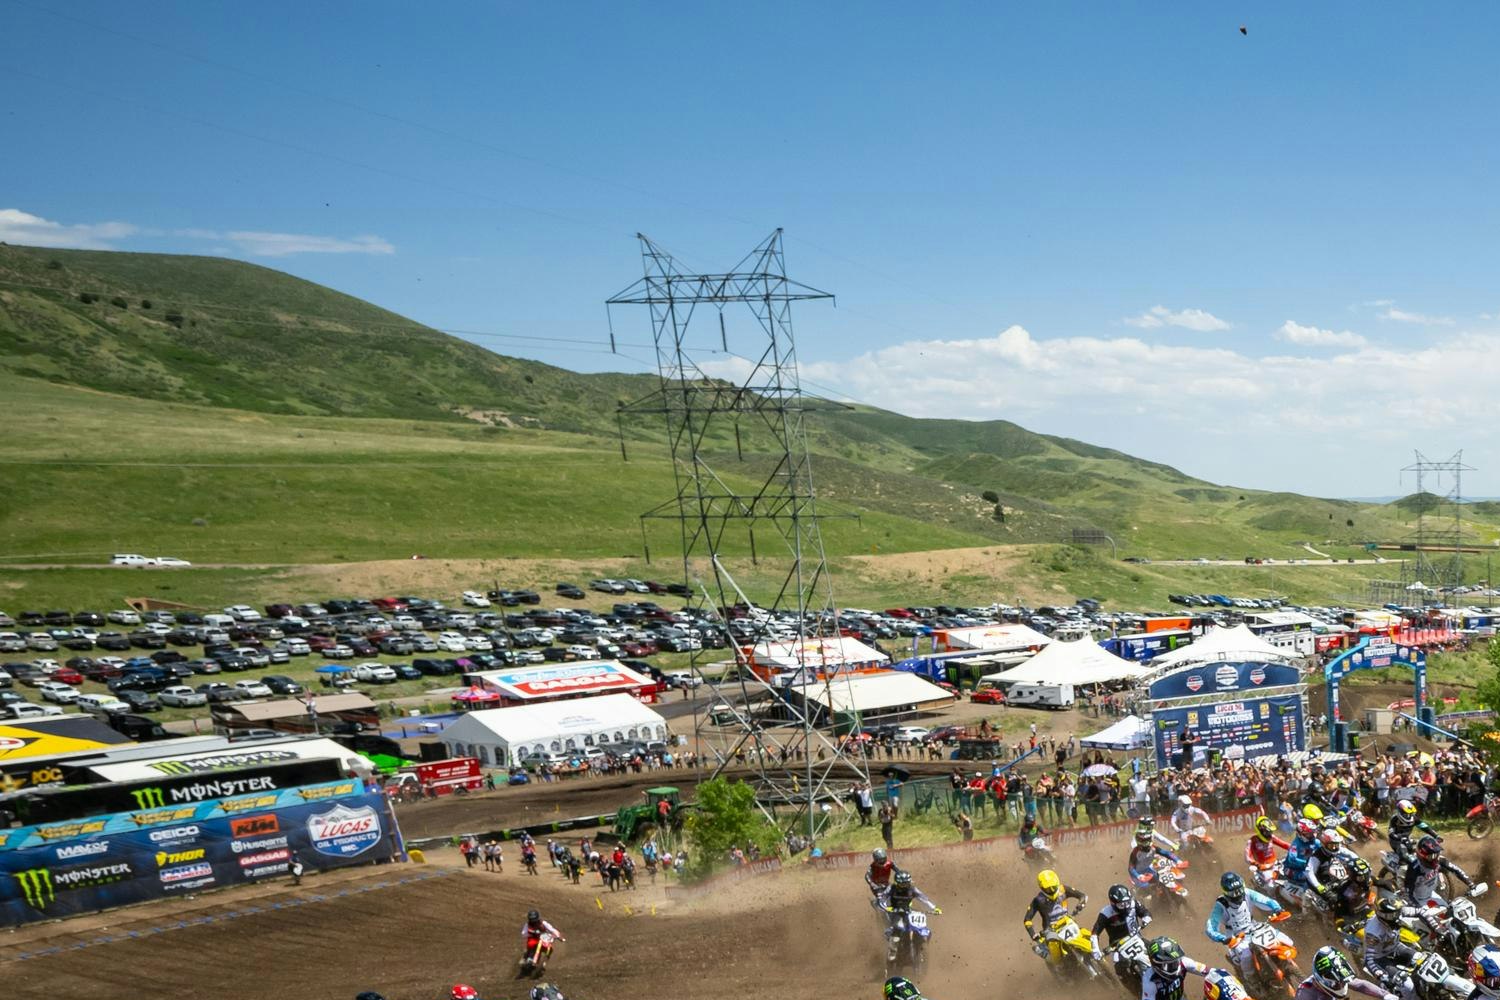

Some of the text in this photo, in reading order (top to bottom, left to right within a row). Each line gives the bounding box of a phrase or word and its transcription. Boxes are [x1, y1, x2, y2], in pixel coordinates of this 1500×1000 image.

[528, 674, 625, 690] GASGAS
[171, 776, 277, 801] MONSTER
[236, 819, 276, 836] KTM
[320, 818, 372, 838] LUCAS
[1213, 814, 1244, 832] LUCAS
[150, 826, 200, 841] GEICO
[317, 832, 378, 849] OIL PRODUCTS
[168, 849, 205, 864] THOR
[240, 851, 288, 865] GASGAS
[55, 863, 132, 884] MONSTER
[1256, 929, 1275, 945] 73
[1425, 959, 1447, 980] 12
